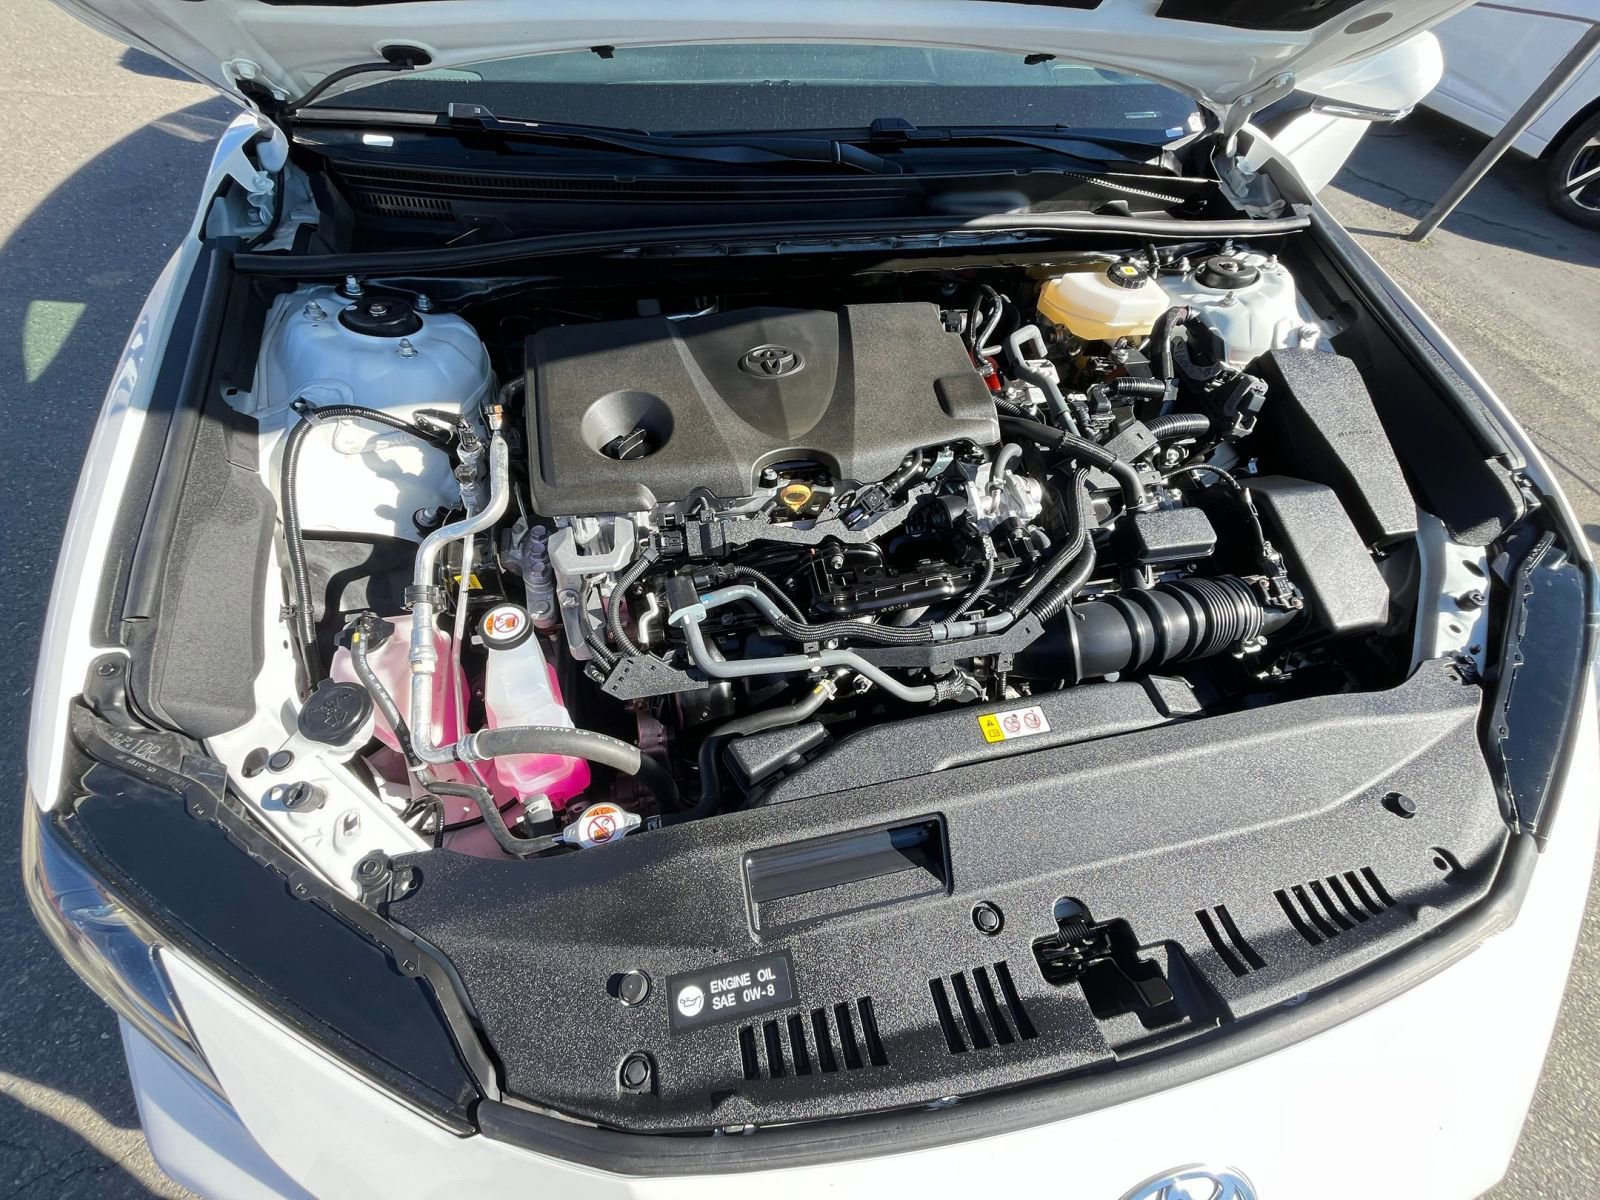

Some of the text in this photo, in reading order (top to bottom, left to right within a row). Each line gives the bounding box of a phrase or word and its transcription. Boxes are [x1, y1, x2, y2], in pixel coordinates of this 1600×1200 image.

[709, 967, 776, 994] ENGINE OIL
[712, 983, 775, 1010] SAE 0W-8
